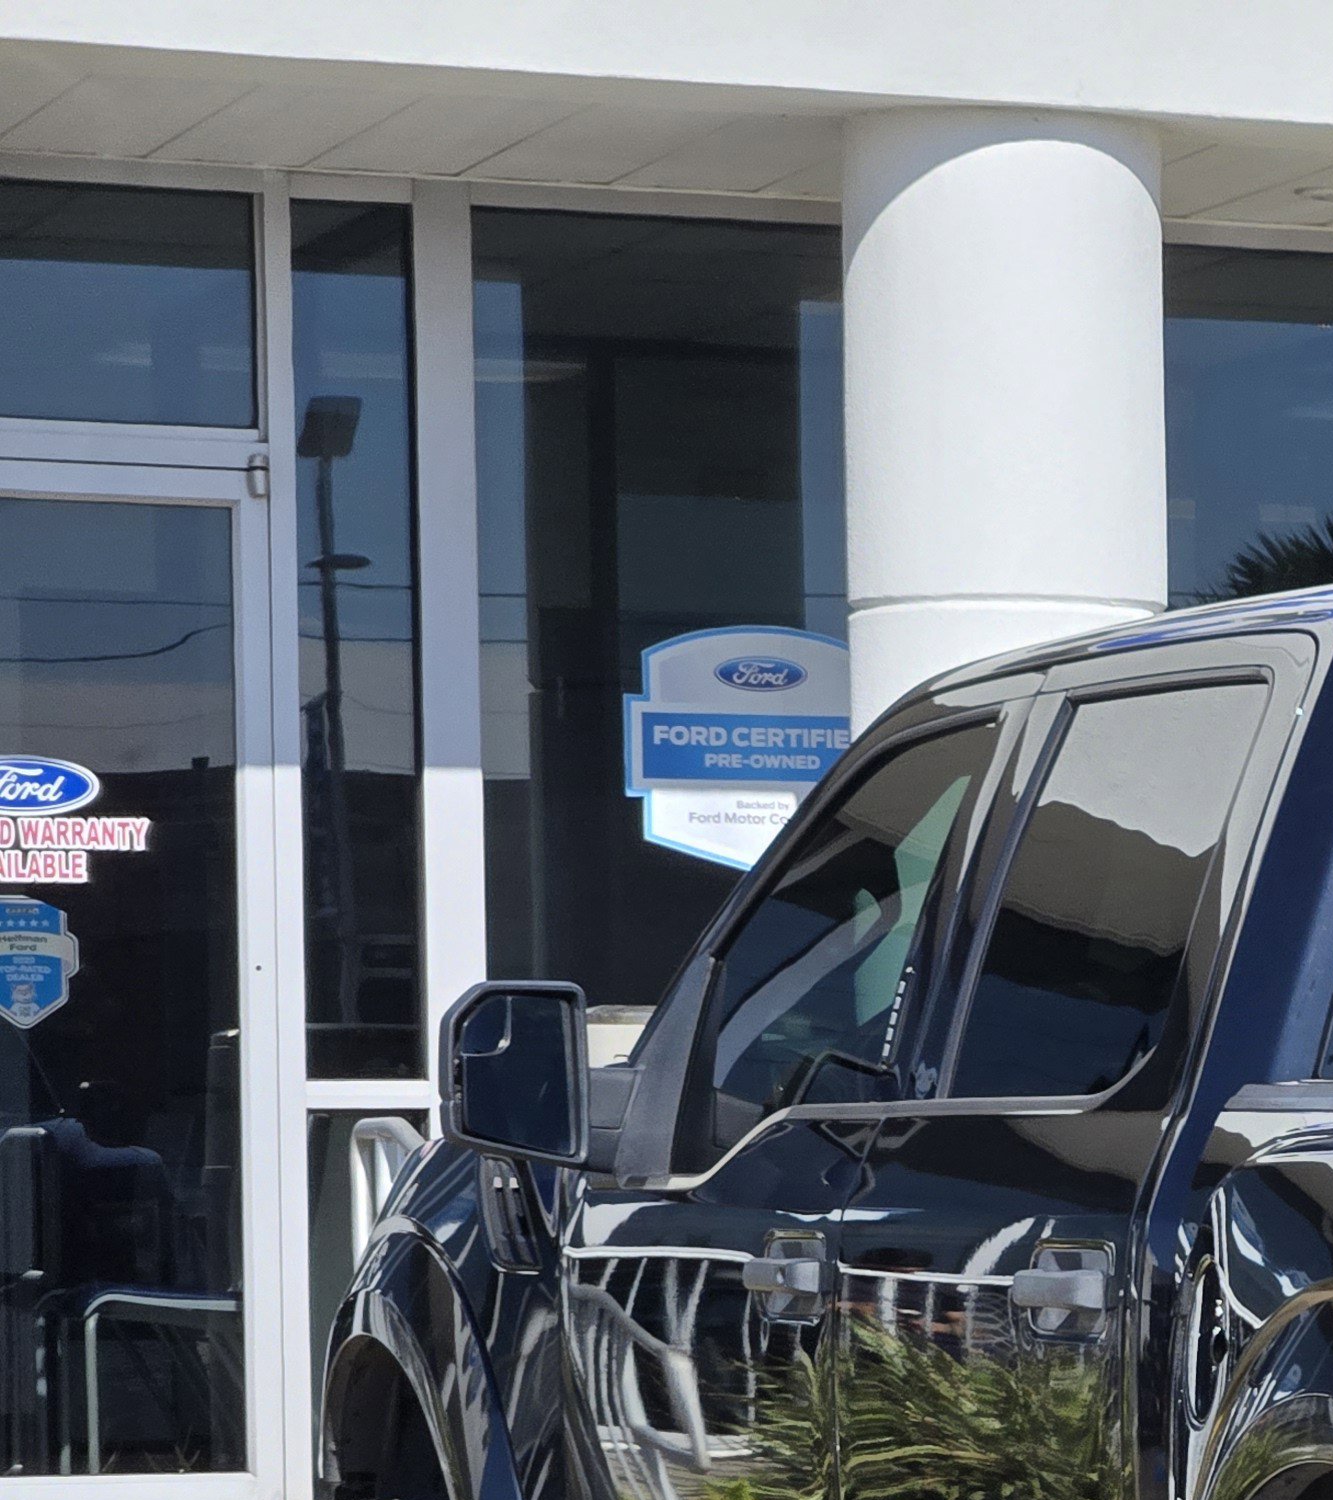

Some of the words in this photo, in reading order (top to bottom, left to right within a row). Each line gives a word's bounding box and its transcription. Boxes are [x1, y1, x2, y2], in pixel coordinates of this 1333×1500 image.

[733, 661, 790, 686] Ford
[652, 724, 729, 746] FORD
[704, 753, 822, 770] PRE-OWNED
[736, 800, 776, 810] Backed
[777, 800, 791, 811] by
[688, 811, 721, 824] Ford
[724, 811, 767, 825] Motor
[19, 818, 147, 848] WARRANTY
